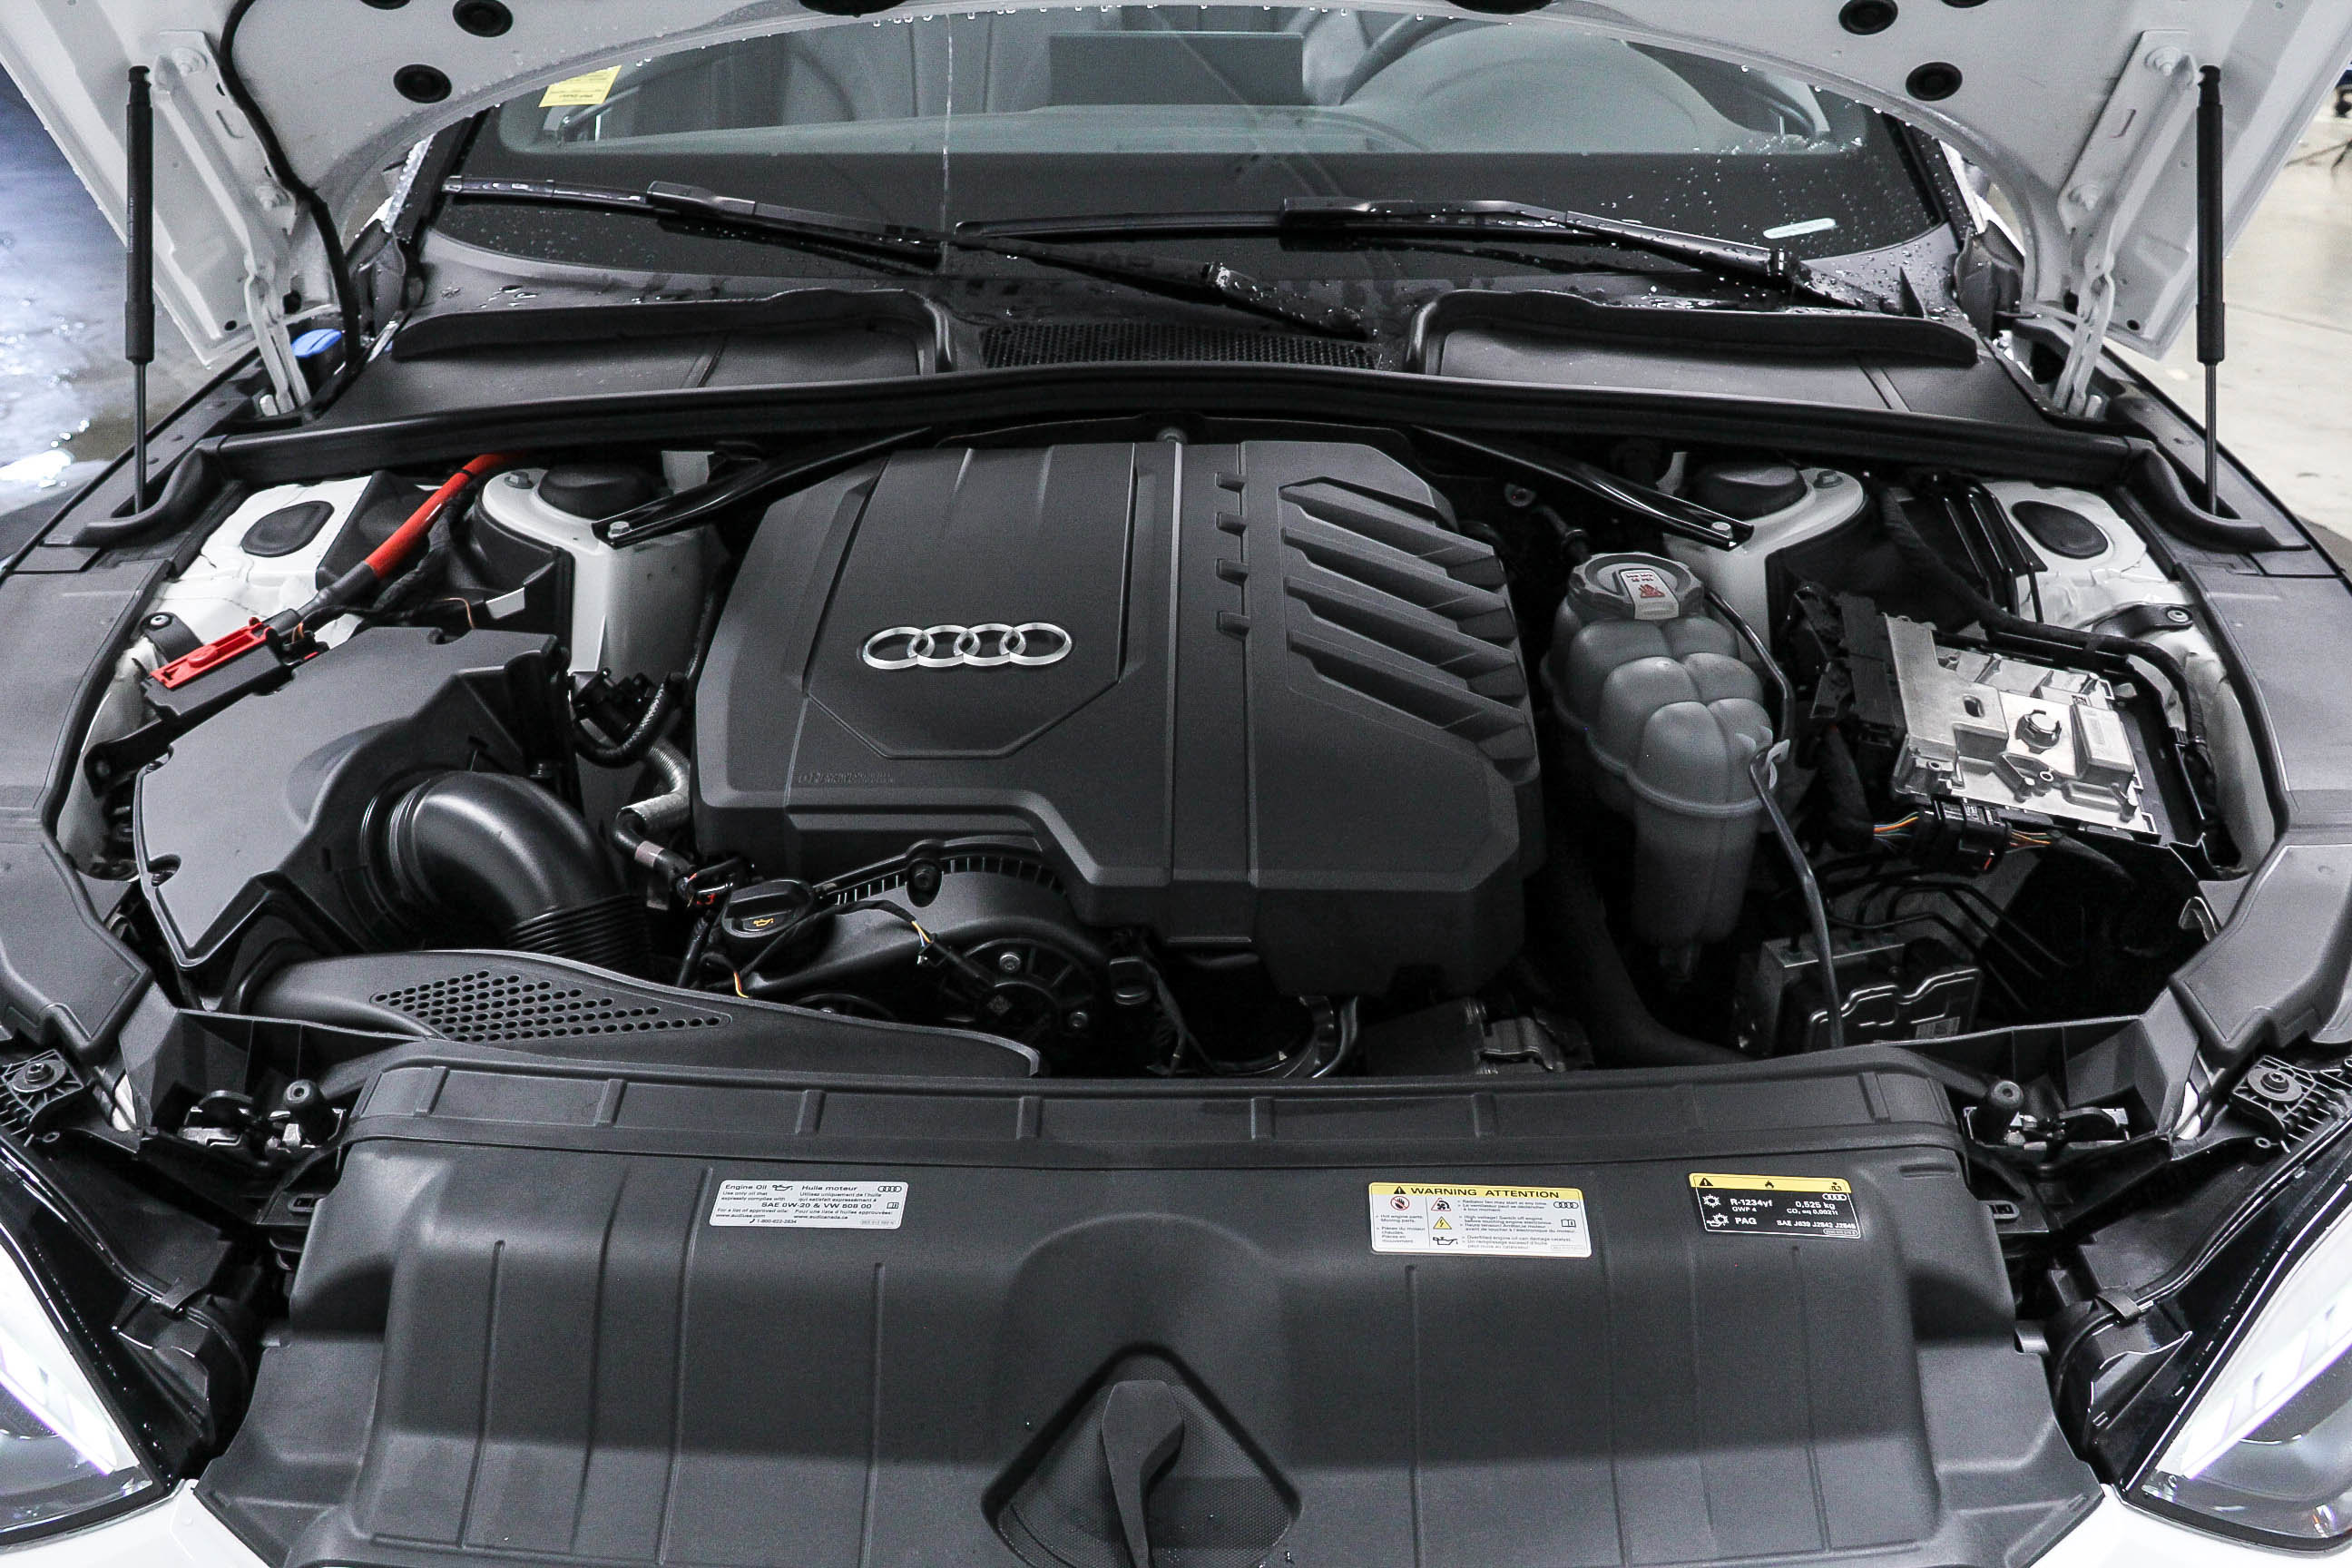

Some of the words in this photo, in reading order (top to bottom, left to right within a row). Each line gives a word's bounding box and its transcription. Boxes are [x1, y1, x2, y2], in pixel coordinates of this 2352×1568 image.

[1411, 1187, 1477, 1196] WARNING
[1485, 1190, 1559, 1198] ATTENTION
[1730, 1198, 1772, 1207] R-1234yf
